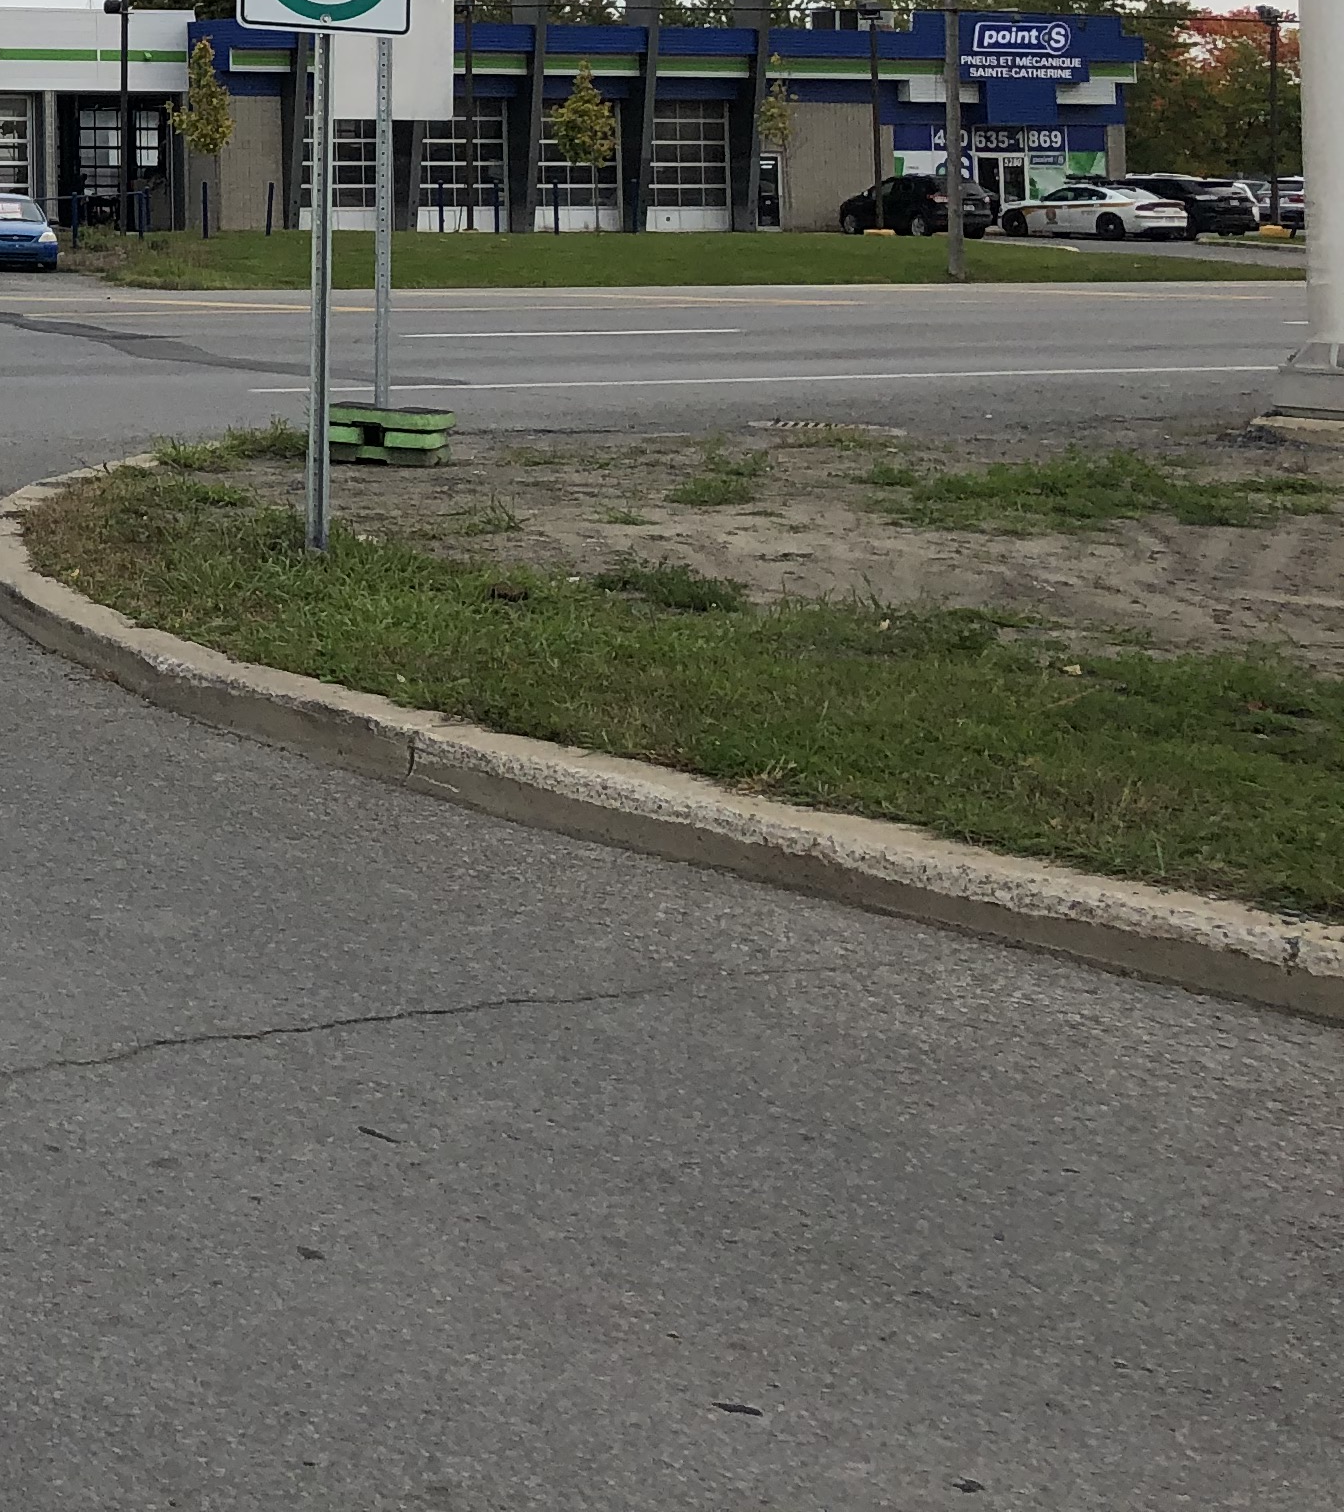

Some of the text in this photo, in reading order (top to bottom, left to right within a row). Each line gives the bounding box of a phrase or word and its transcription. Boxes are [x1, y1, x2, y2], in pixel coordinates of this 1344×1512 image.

[983, 27, 1066, 48] point S
[960, 55, 1082, 68] PNEUS ET MÉCANIQUE
[969, 68, 1072, 79] SAINTE-CATHERINE
[934, 129, 1062, 148] 40 635-1869
